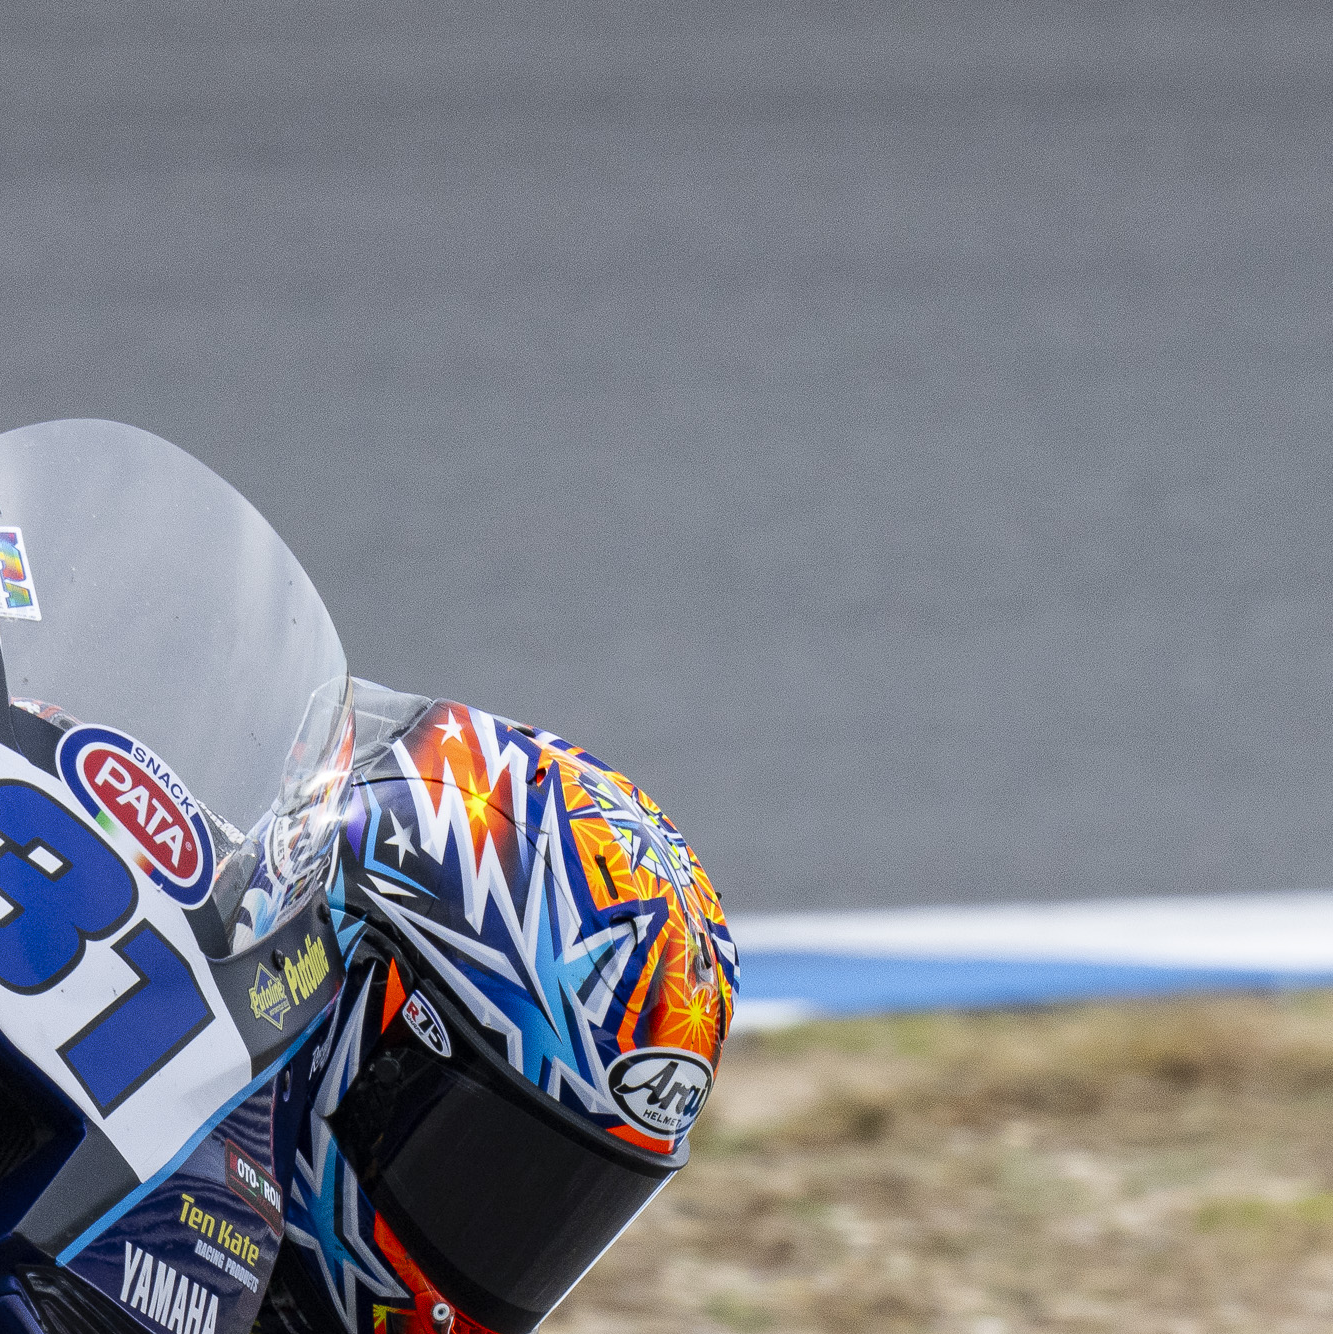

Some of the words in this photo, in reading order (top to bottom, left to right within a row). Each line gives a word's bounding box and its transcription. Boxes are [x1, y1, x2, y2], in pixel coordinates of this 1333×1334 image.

[94, 755, 185, 868] PATA
[132, 746, 196, 817] SNACK
[251, 974, 285, 1016] Putoline
[284, 934, 330, 1005] Putoline
[405, 1000, 444, 1053] R75
[180, 1193, 215, 1238] Ten
[217, 1220, 260, 1267] Kate
[194, 1239, 226, 1270] RACING
[225, 1257, 259, 1294] PRODUCTS
